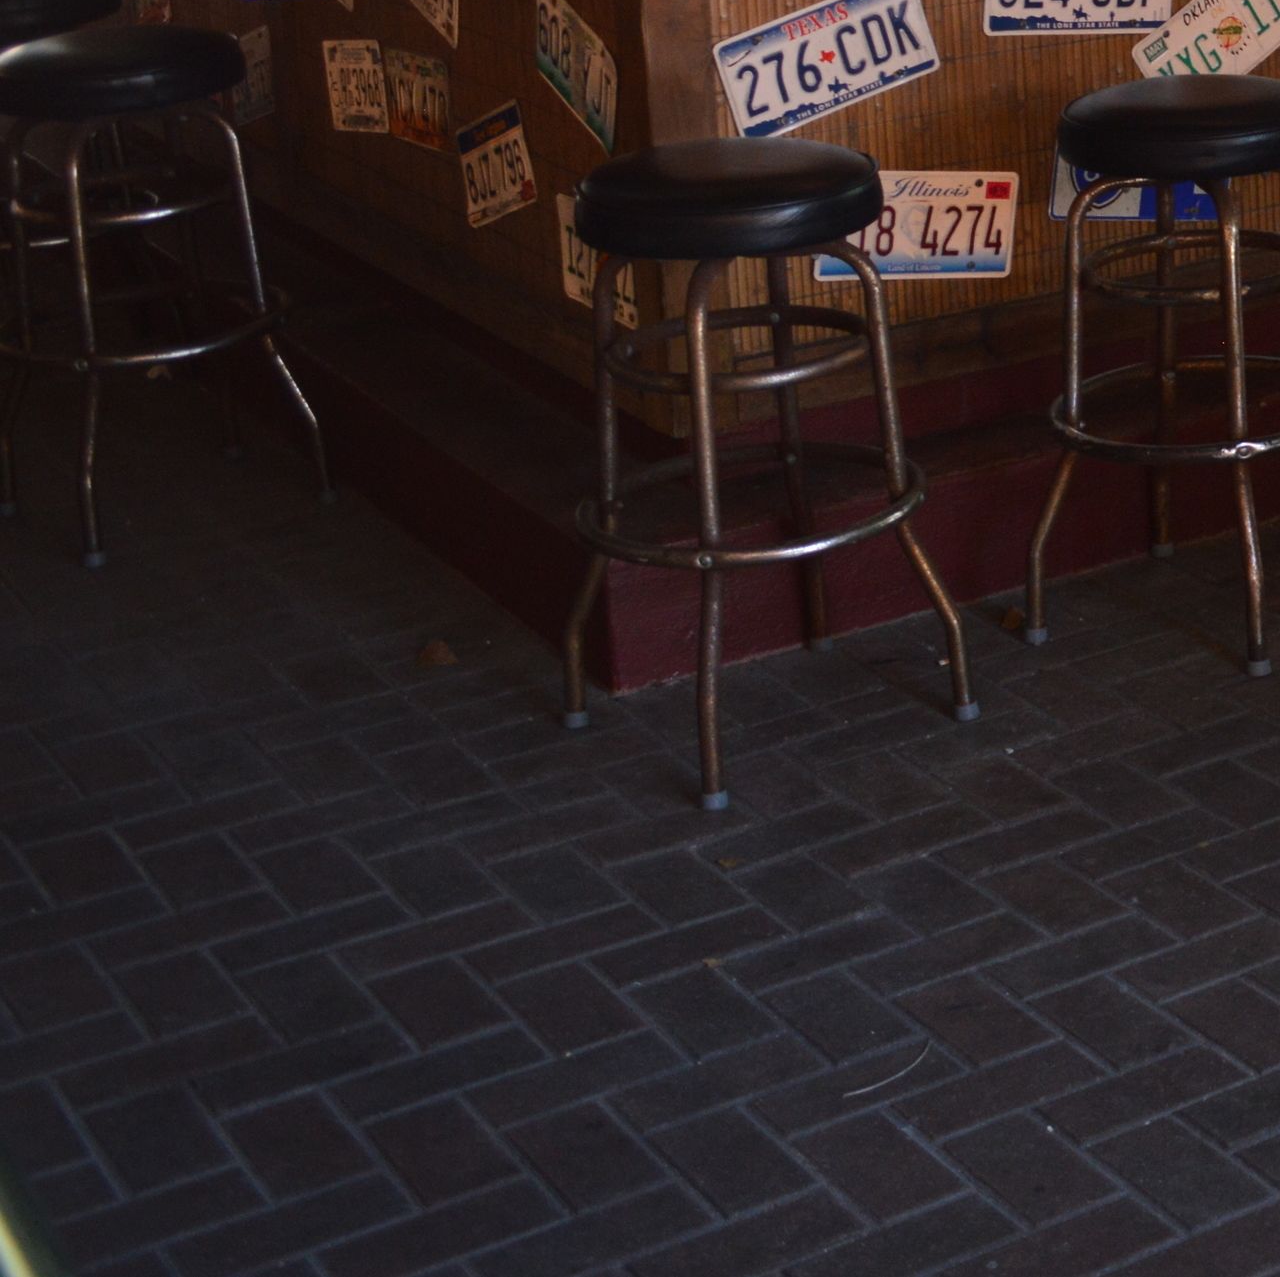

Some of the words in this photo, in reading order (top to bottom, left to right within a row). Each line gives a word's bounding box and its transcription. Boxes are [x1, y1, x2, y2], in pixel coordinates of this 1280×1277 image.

[780, 1, 850, 42] TEXAS
[735, 40, 823, 118] 276
[835, 0, 921, 76] CDK
[493, 137, 526, 190] 796
[891, 176, 971, 199] Illinois
[920, 204, 1003, 257] 4274
